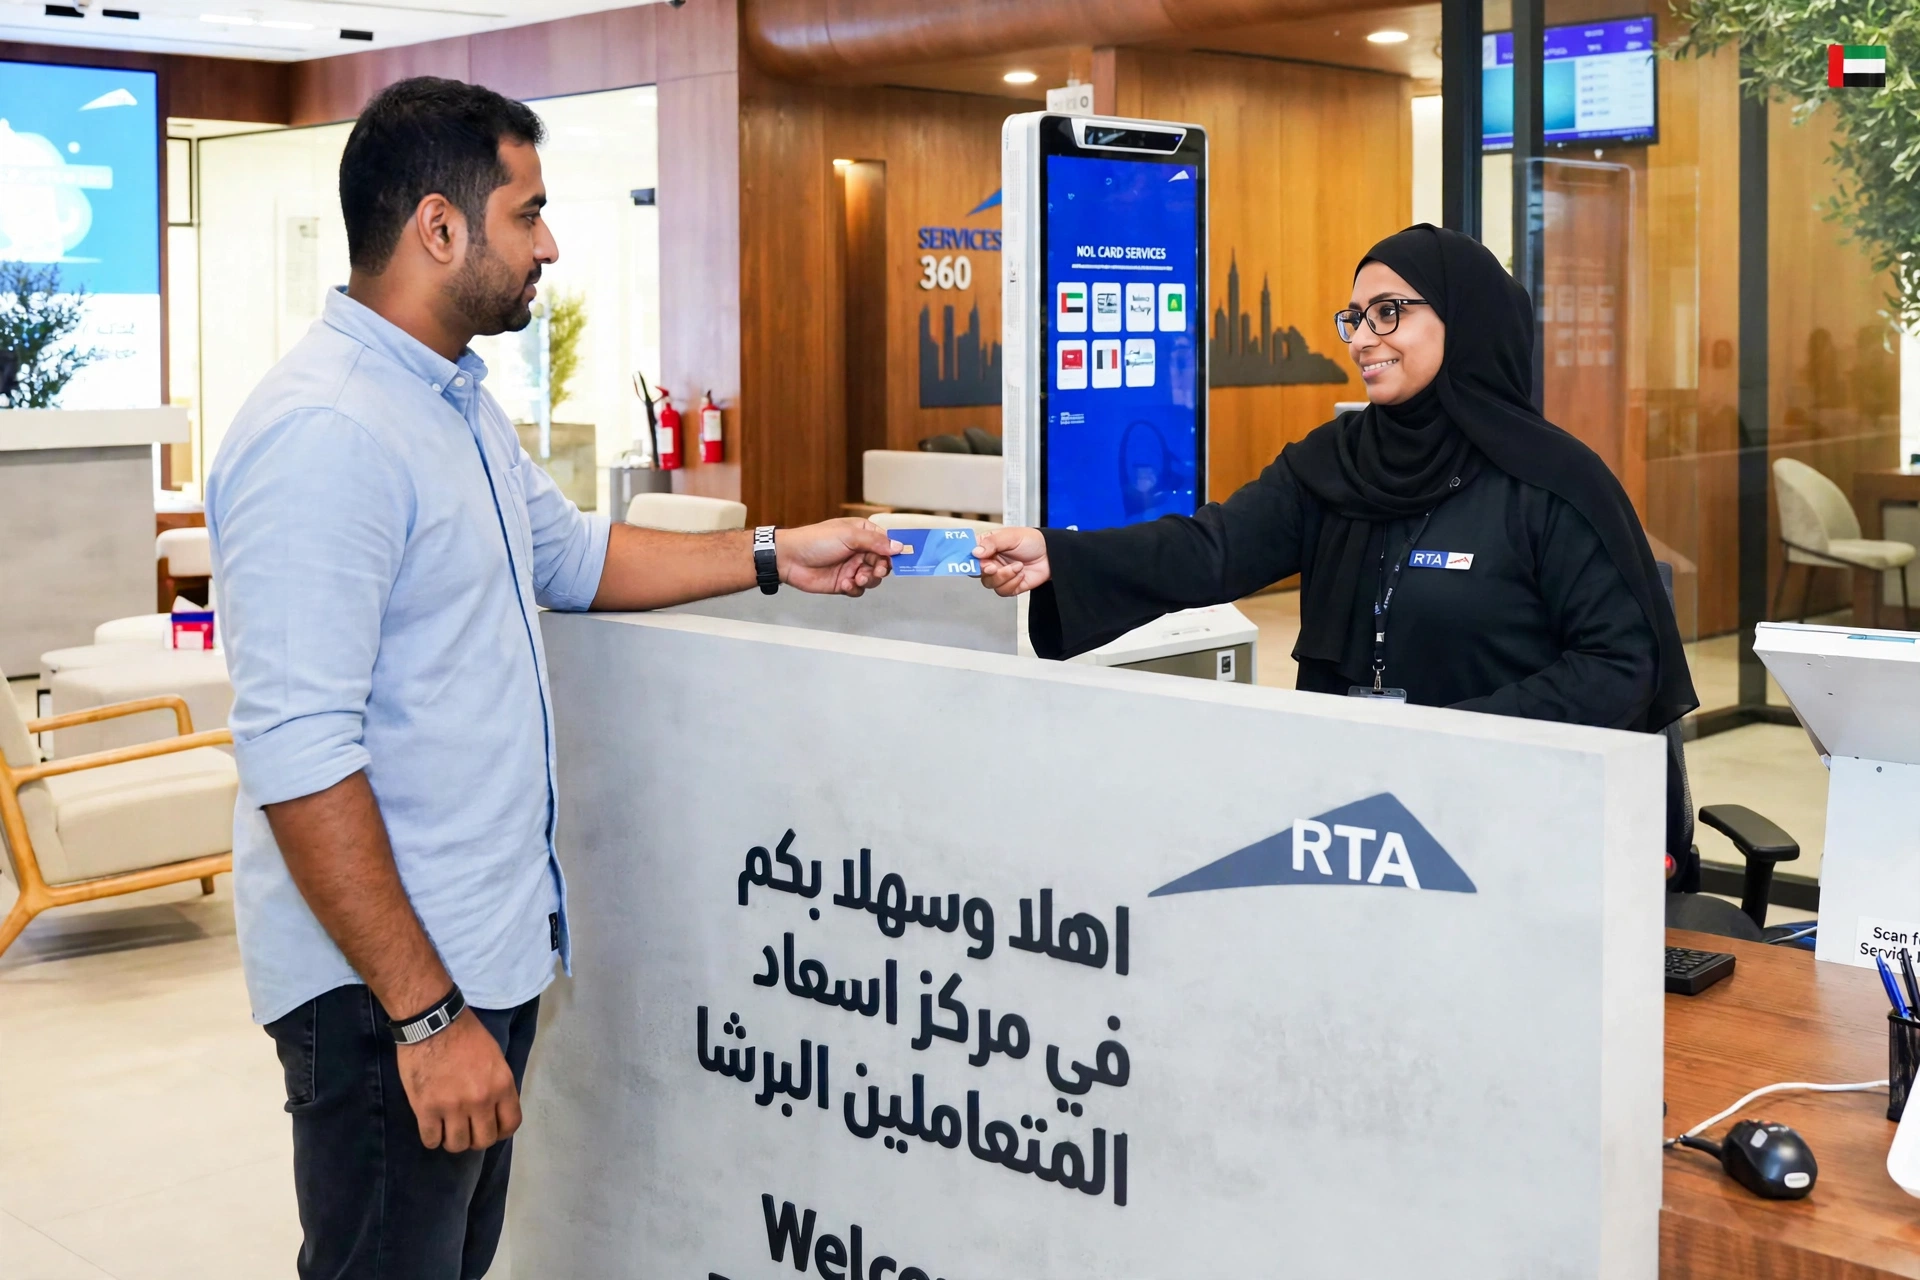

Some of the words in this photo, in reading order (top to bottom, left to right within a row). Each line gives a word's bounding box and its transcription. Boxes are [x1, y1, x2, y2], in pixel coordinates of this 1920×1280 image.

[918, 226, 1002, 251] SERVICES
[919, 255, 972, 290] 360
[1076, 245, 1096, 257] NOL
[1098, 246, 1124, 259] CARD
[1125, 247, 1167, 260] SERVICES
[945, 531, 969, 540] RTA
[947, 560, 977, 573] nol
[1413, 553, 1442, 566] RTA
[738, 829, 821, 921] بكم
[1292, 818, 1421, 890] RTA
[834, 848, 995, 960] وسهلا
[1009, 889, 1130, 976] اهلا
[1873, 926, 1908, 944] Scan
[753, 932, 898, 1026] اسعاد
[911, 970, 1031, 1068] مركز
[697, 1006, 829, 1118] البرشا
[1046, 1016, 1130, 1118] في
[844, 1063, 1128, 1207] المتعاملين
